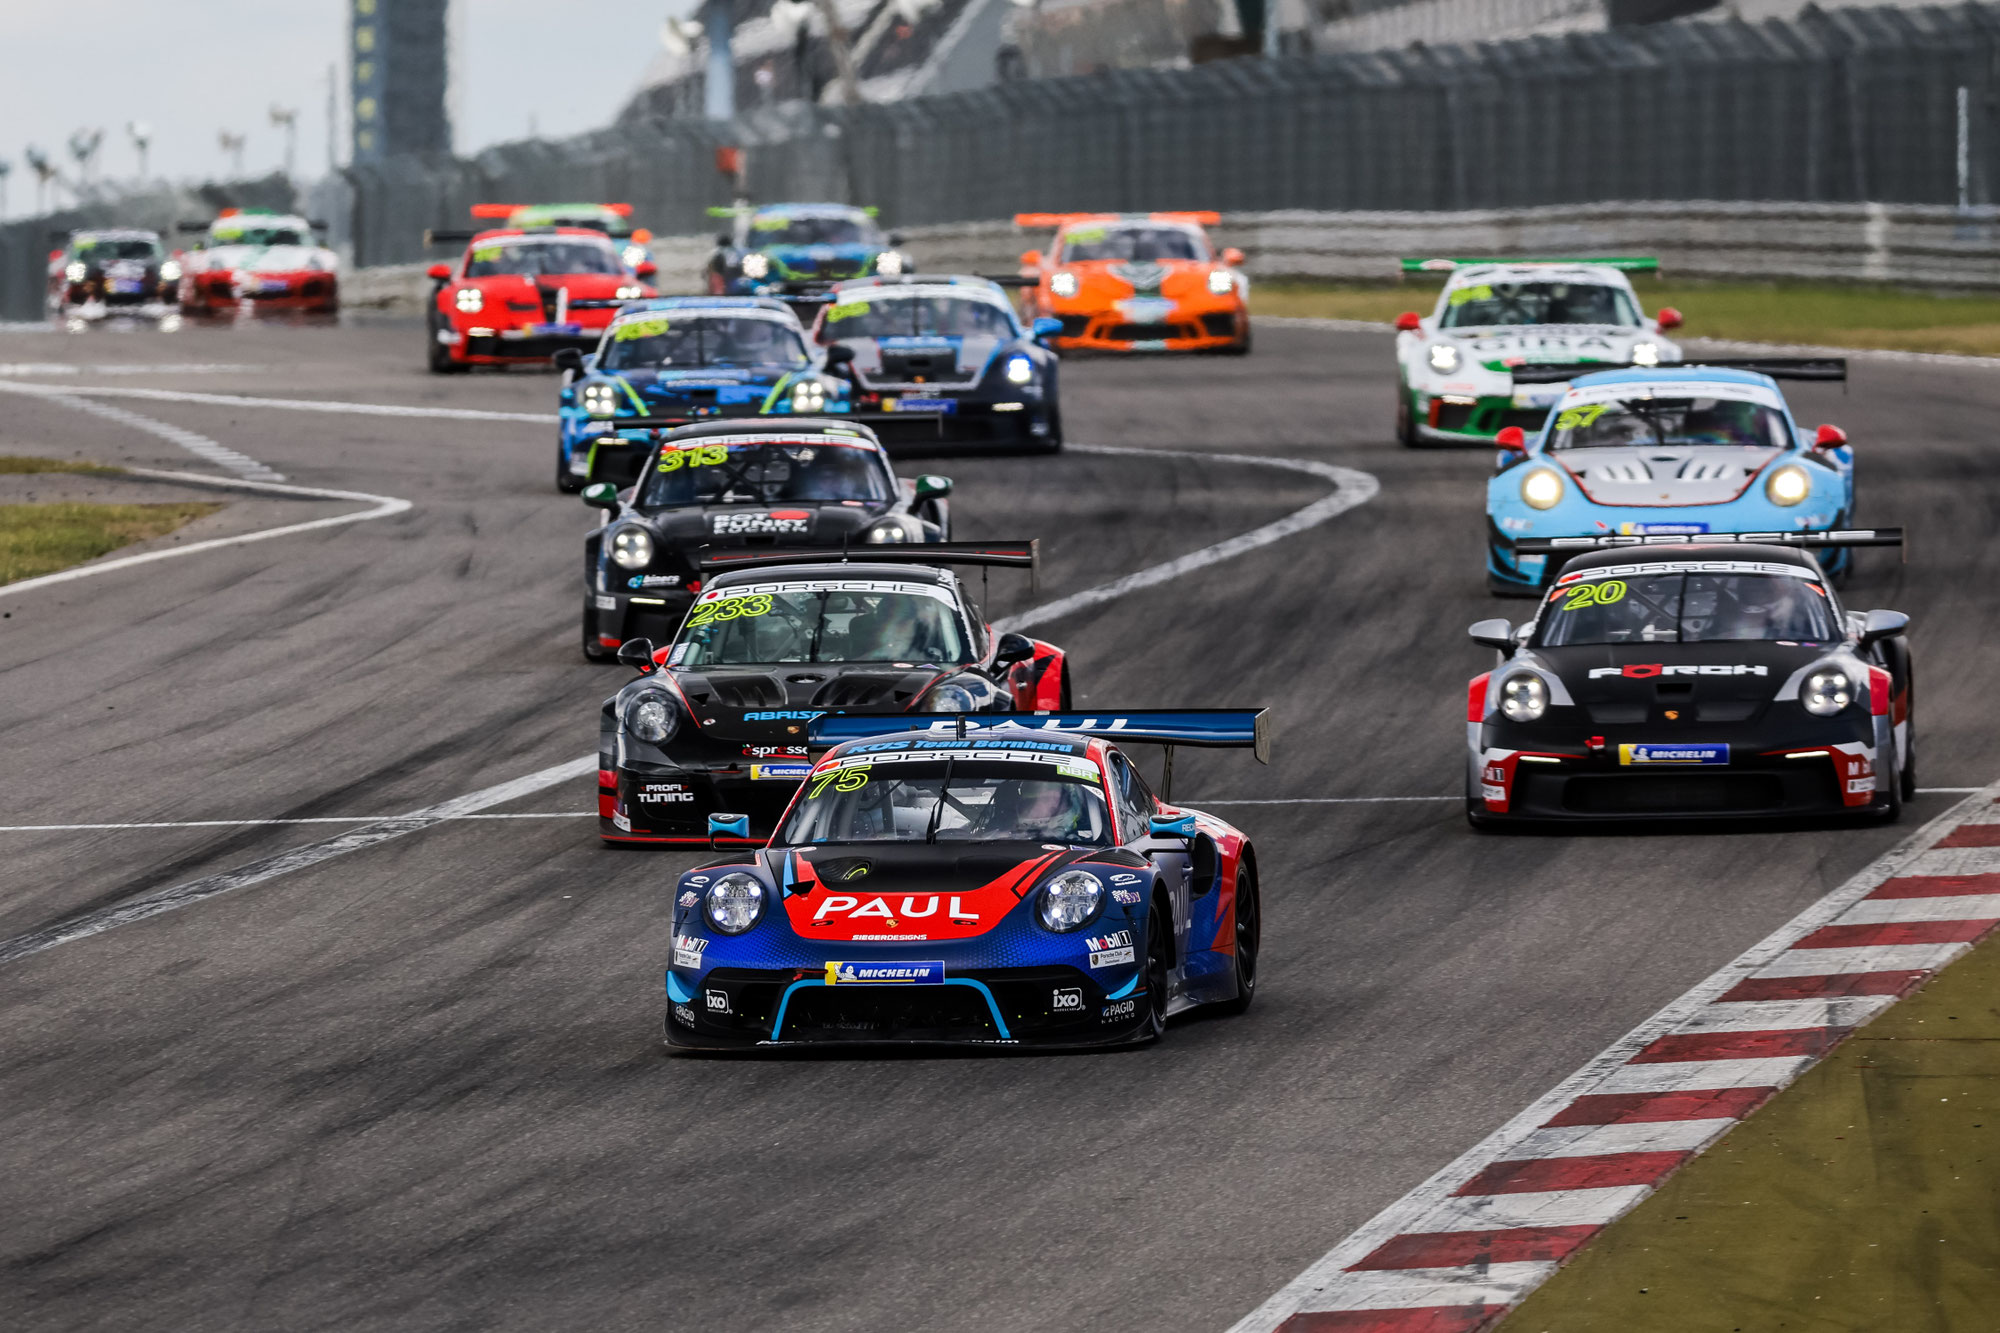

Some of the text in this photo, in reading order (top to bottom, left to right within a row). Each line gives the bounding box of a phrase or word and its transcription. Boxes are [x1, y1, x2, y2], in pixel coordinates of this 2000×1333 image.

[1555, 404, 1610, 431] 57
[657, 445, 729, 473] 313
[1551, 531, 1876, 547] PORSCHE
[1580, 563, 1793, 577] PORSCHE
[723, 582, 929, 597] PORSCHE
[1562, 580, 1627, 611] 20
[686, 593, 774, 628] 233
[914, 740, 971, 749] Team
[972, 740, 1074, 753] Bernhard
[840, 752, 1072, 767] PORSCHE
[1650, 750, 1717, 759] MICHELIN
[1058, 766, 1095, 780] NBR
[646, 784, 682, 792] PROFI
[808, 764, 873, 799] 75
[637, 792, 694, 803] TUNING
[812, 895, 980, 920] PAUL
[1084, 930, 1133, 952] Mobil 1
[858, 968, 931, 978] MICHELIN
[1109, 1000, 1135, 1017] PAGID
